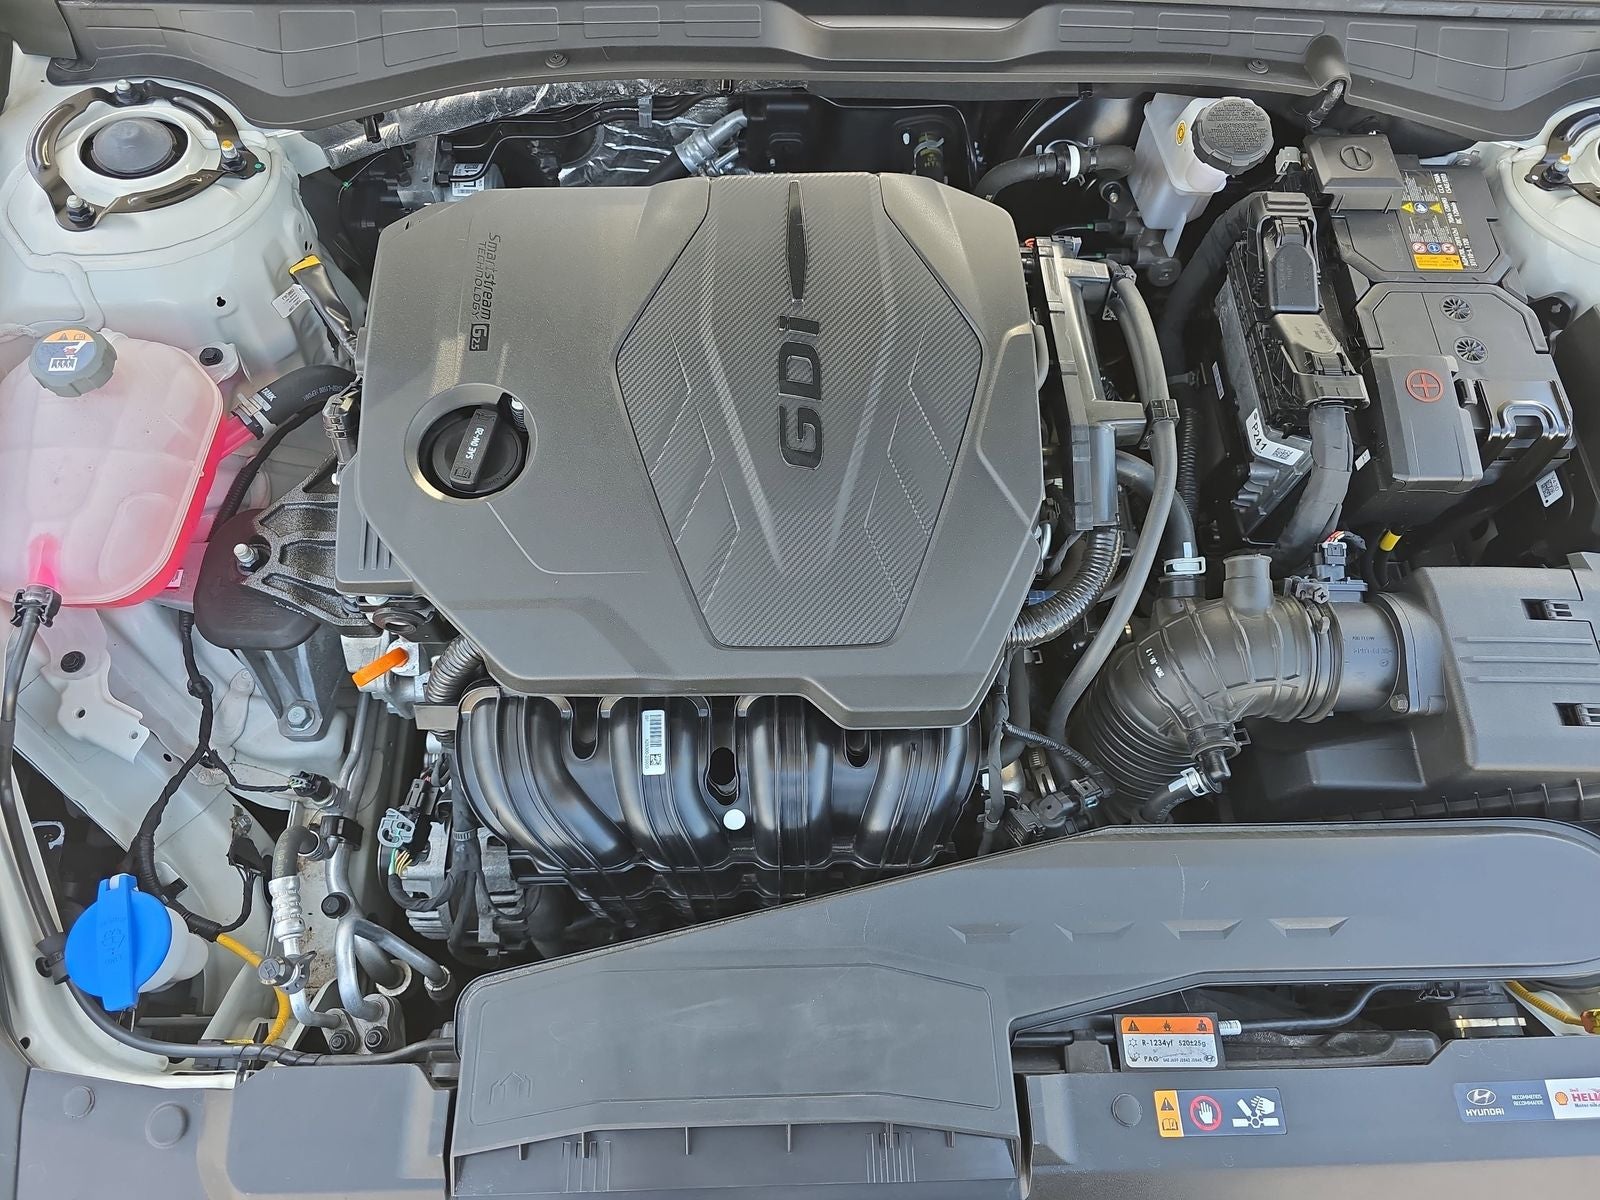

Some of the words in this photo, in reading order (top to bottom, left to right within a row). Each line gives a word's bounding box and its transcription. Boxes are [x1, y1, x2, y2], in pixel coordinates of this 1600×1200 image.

[471, 240, 487, 320] TECHNOLOGY
[481, 232, 501, 320] Smartstream
[465, 447, 477, 460] SAE
[471, 427, 485, 448] 0W-20
[1252, 420, 1267, 452] P241
[1141, 1039, 1173, 1048] R-1234yf
[1465, 1107, 1505, 1117] HYUNDAI
